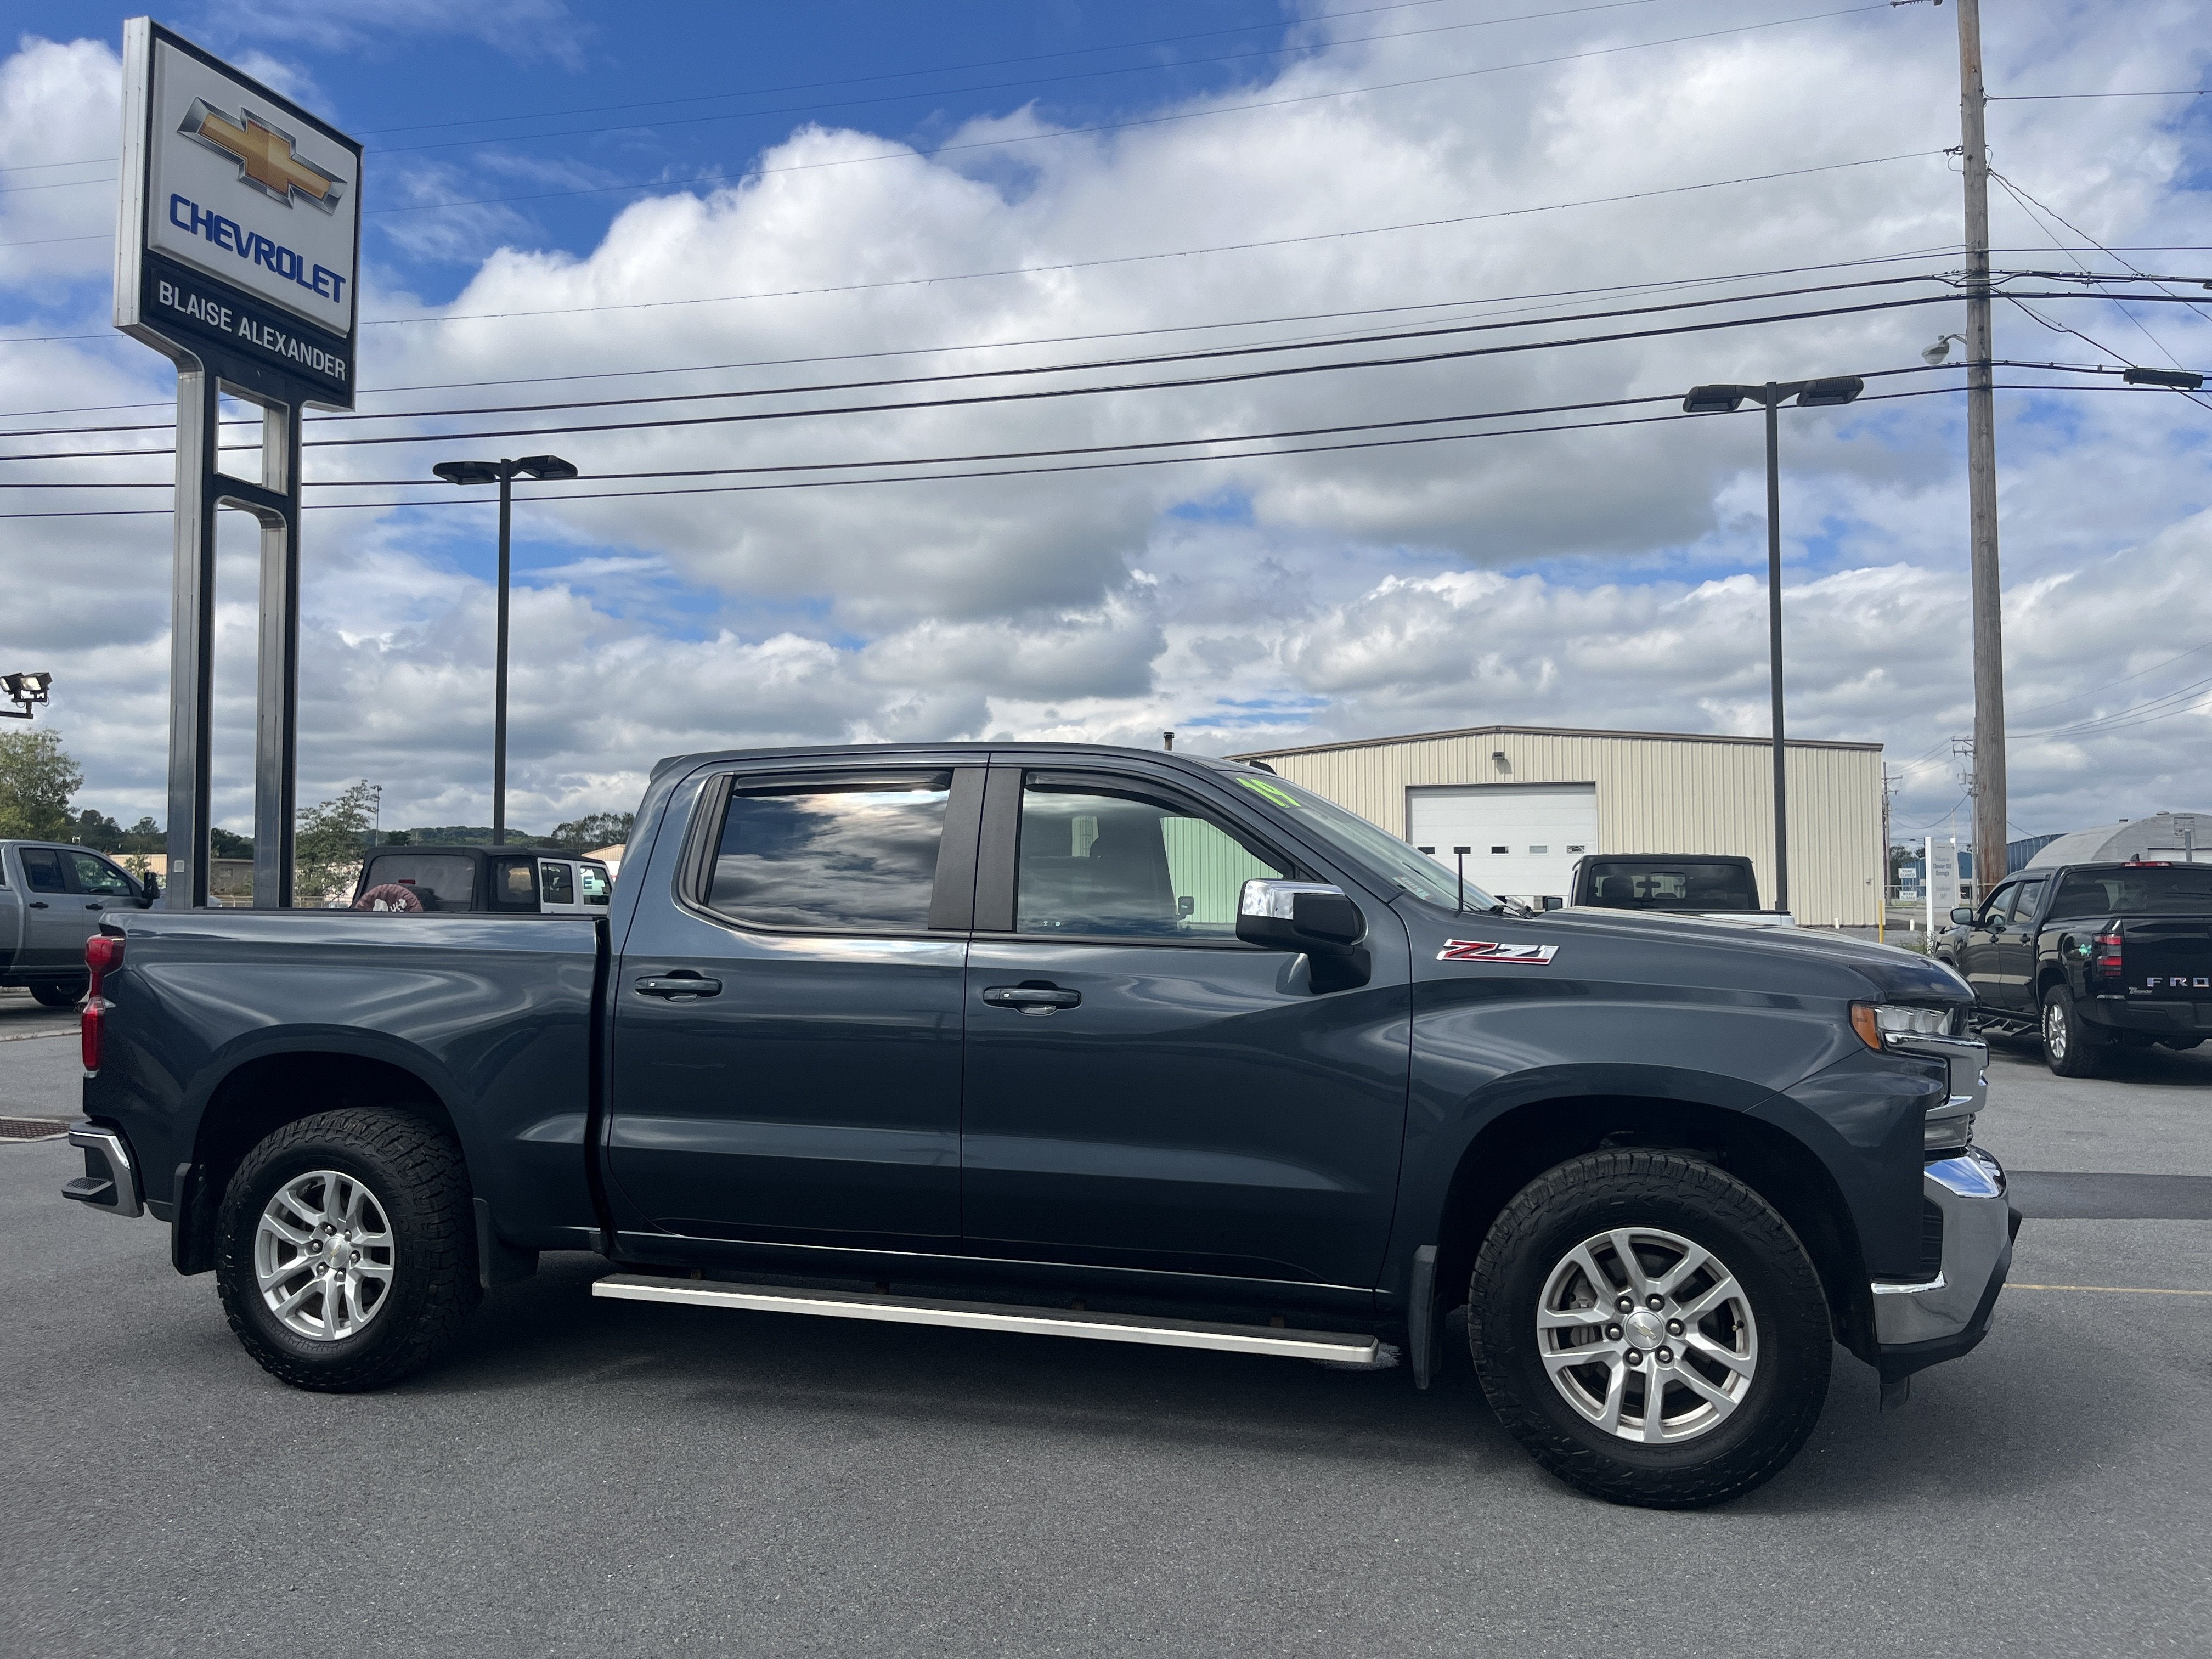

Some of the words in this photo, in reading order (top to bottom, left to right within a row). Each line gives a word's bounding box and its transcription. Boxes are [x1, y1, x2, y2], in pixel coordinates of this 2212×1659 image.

[170, 193, 346, 303] CHEVROLET
[159, 280, 233, 332] BLAISE
[238, 317, 346, 381] ALEXANDER
[1436, 939, 1560, 965] Z71
